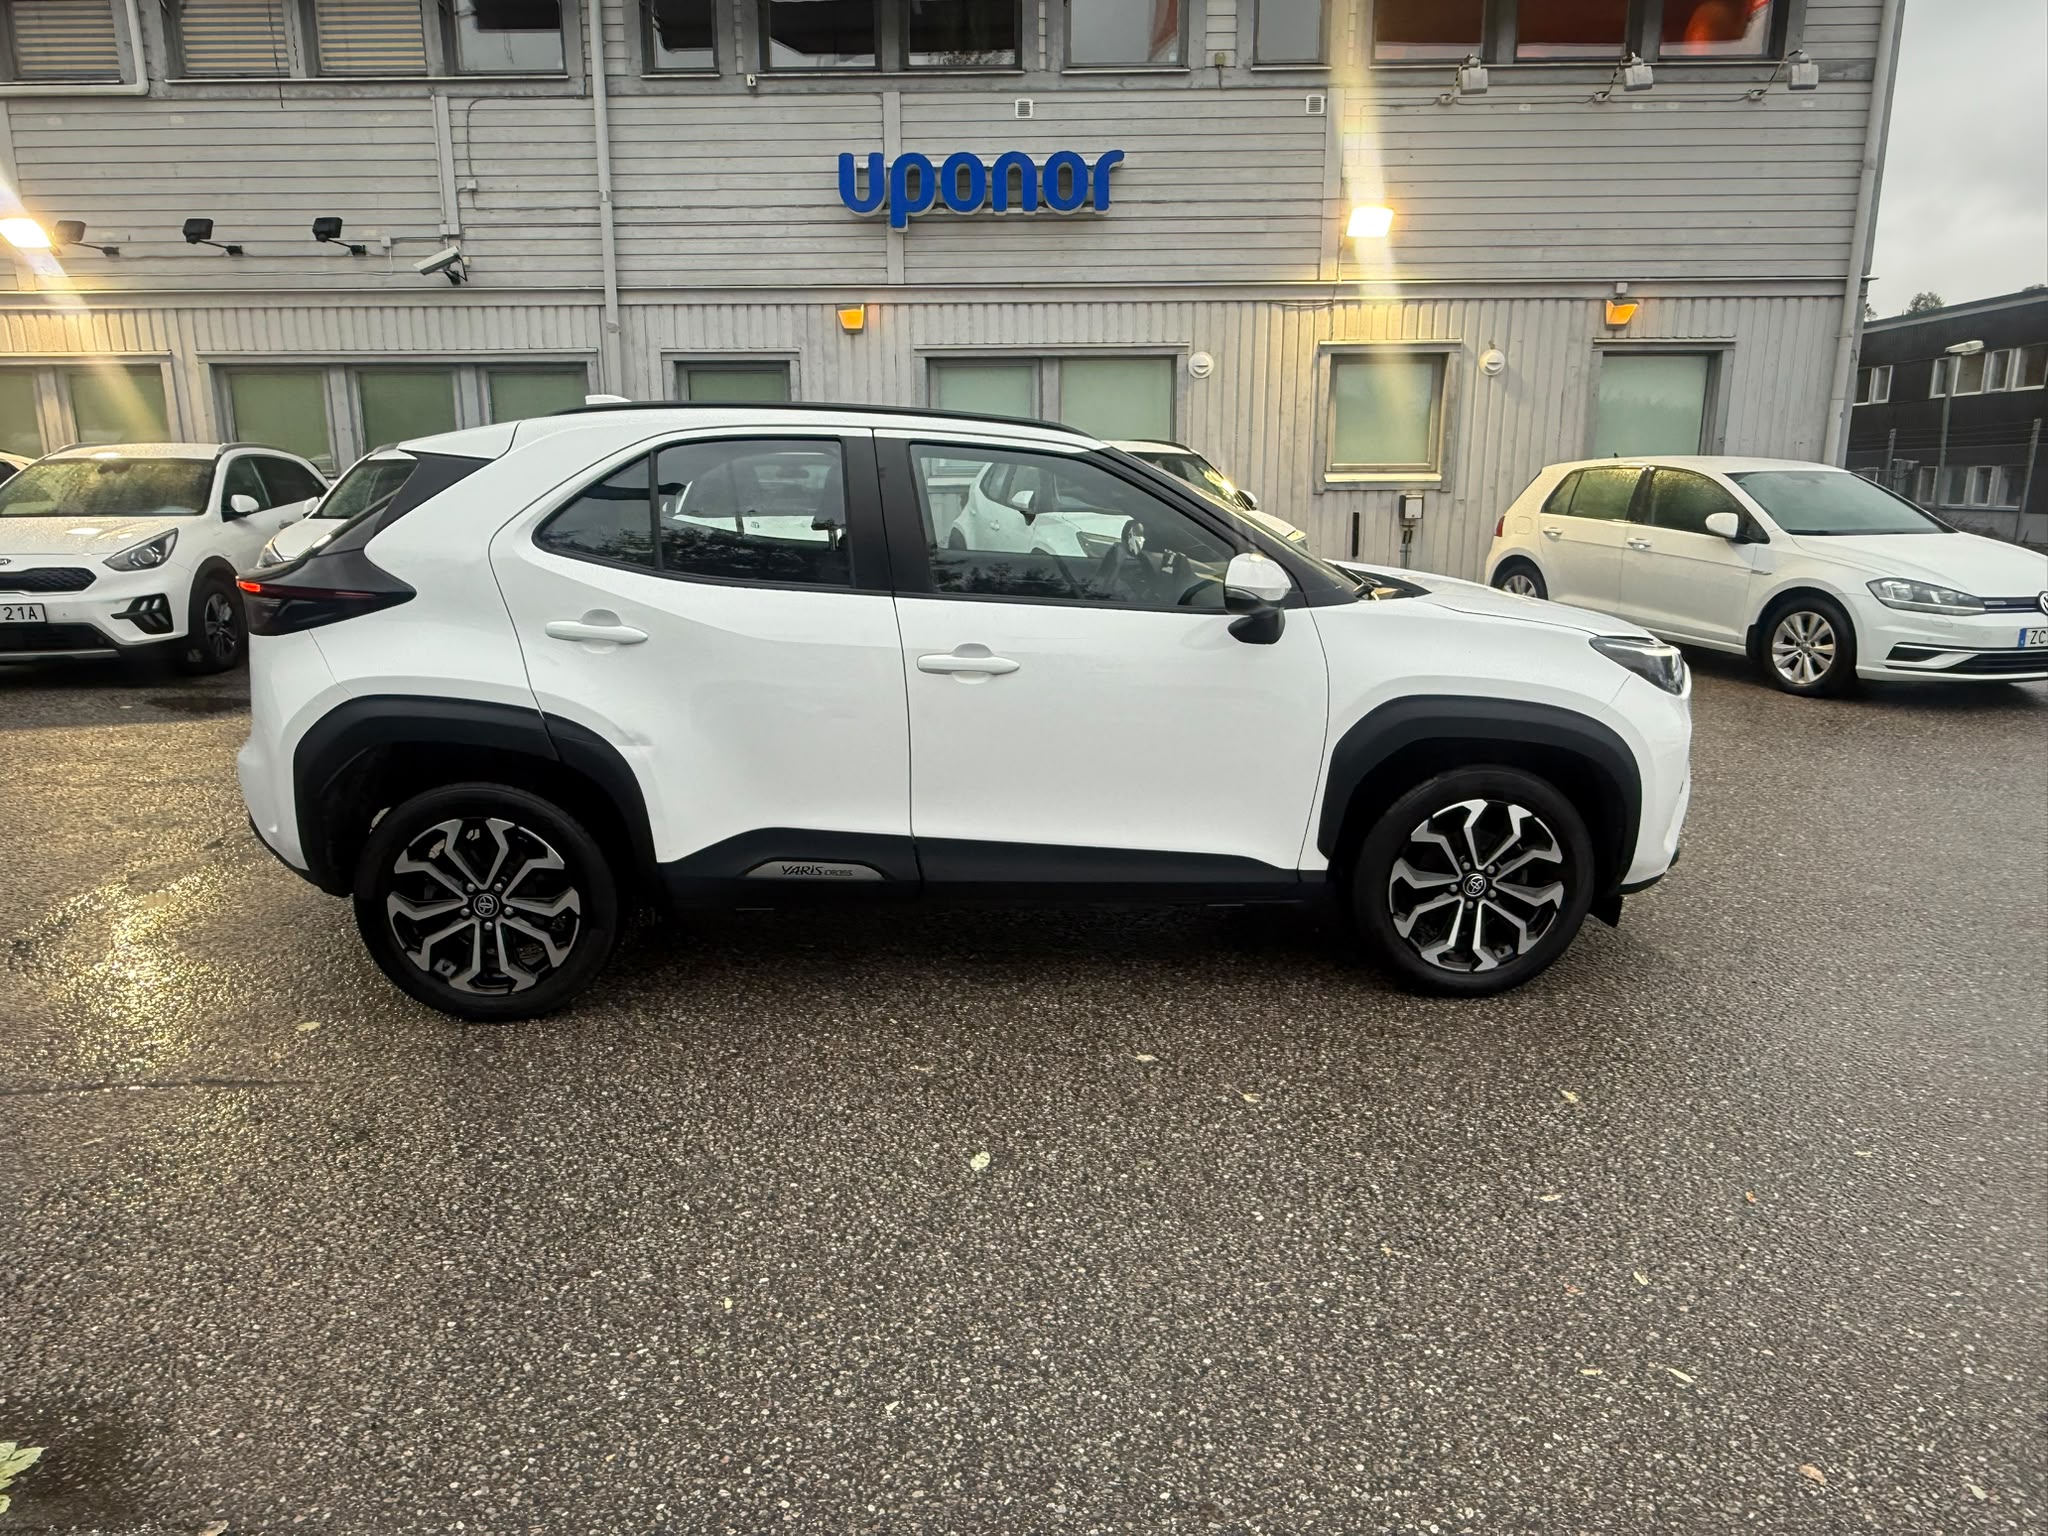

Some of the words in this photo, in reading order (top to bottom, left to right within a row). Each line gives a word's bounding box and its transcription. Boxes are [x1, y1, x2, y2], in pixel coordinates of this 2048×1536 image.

[838, 149, 1125, 231] uponor
[3, 606, 38, 620] 21A
[781, 865, 824, 876] YARIS
